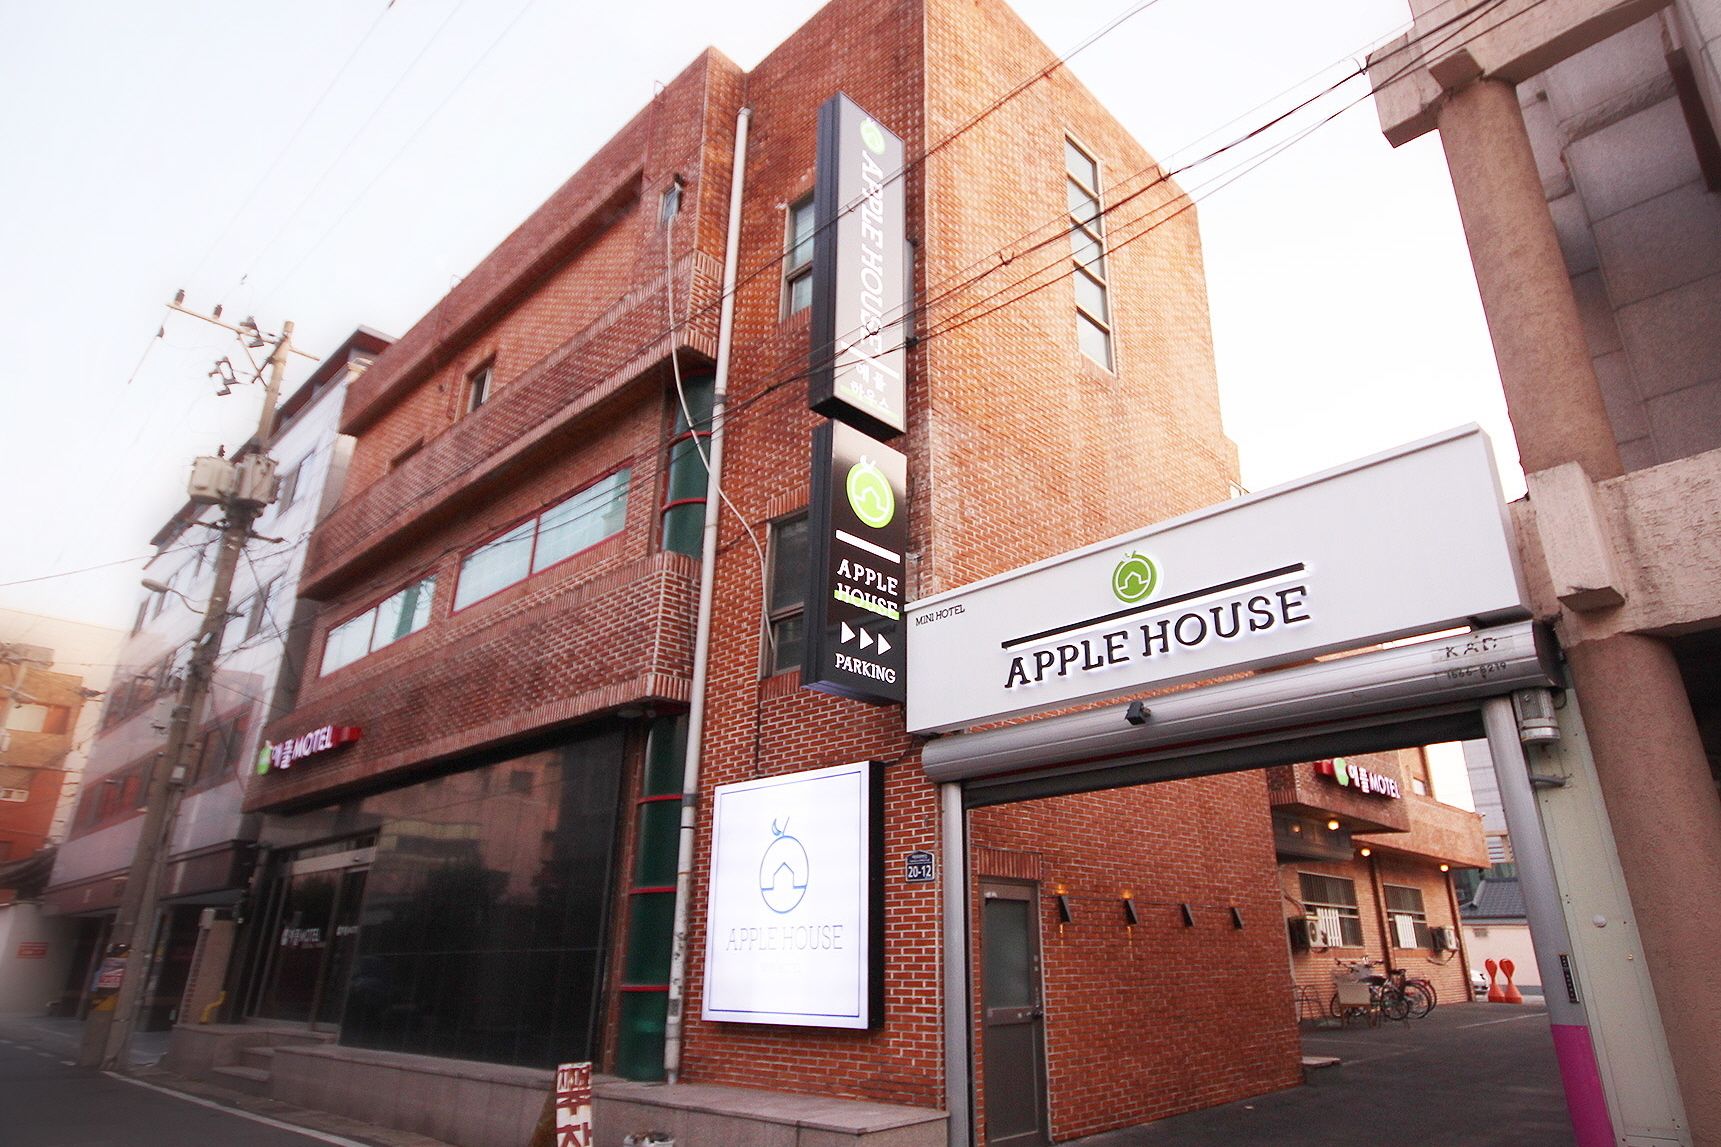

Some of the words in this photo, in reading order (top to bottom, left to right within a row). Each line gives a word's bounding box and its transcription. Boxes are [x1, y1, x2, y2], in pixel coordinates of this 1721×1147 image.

[861, 151, 884, 246] APPLE
[836, 558, 898, 597] APPLE
[837, 581, 898, 617] HOUSE
[915, 612, 935, 627] MINI
[935, 604, 966, 621] HOTEL
[1004, 630, 1131, 690] APPLE
[1140, 584, 1313, 658] HOUSE
[834, 652, 897, 685] PARKING
[908, 864, 933, 878] 20-12
[726, 927, 778, 951] APPLE
[782, 924, 844, 950] HOUSE
